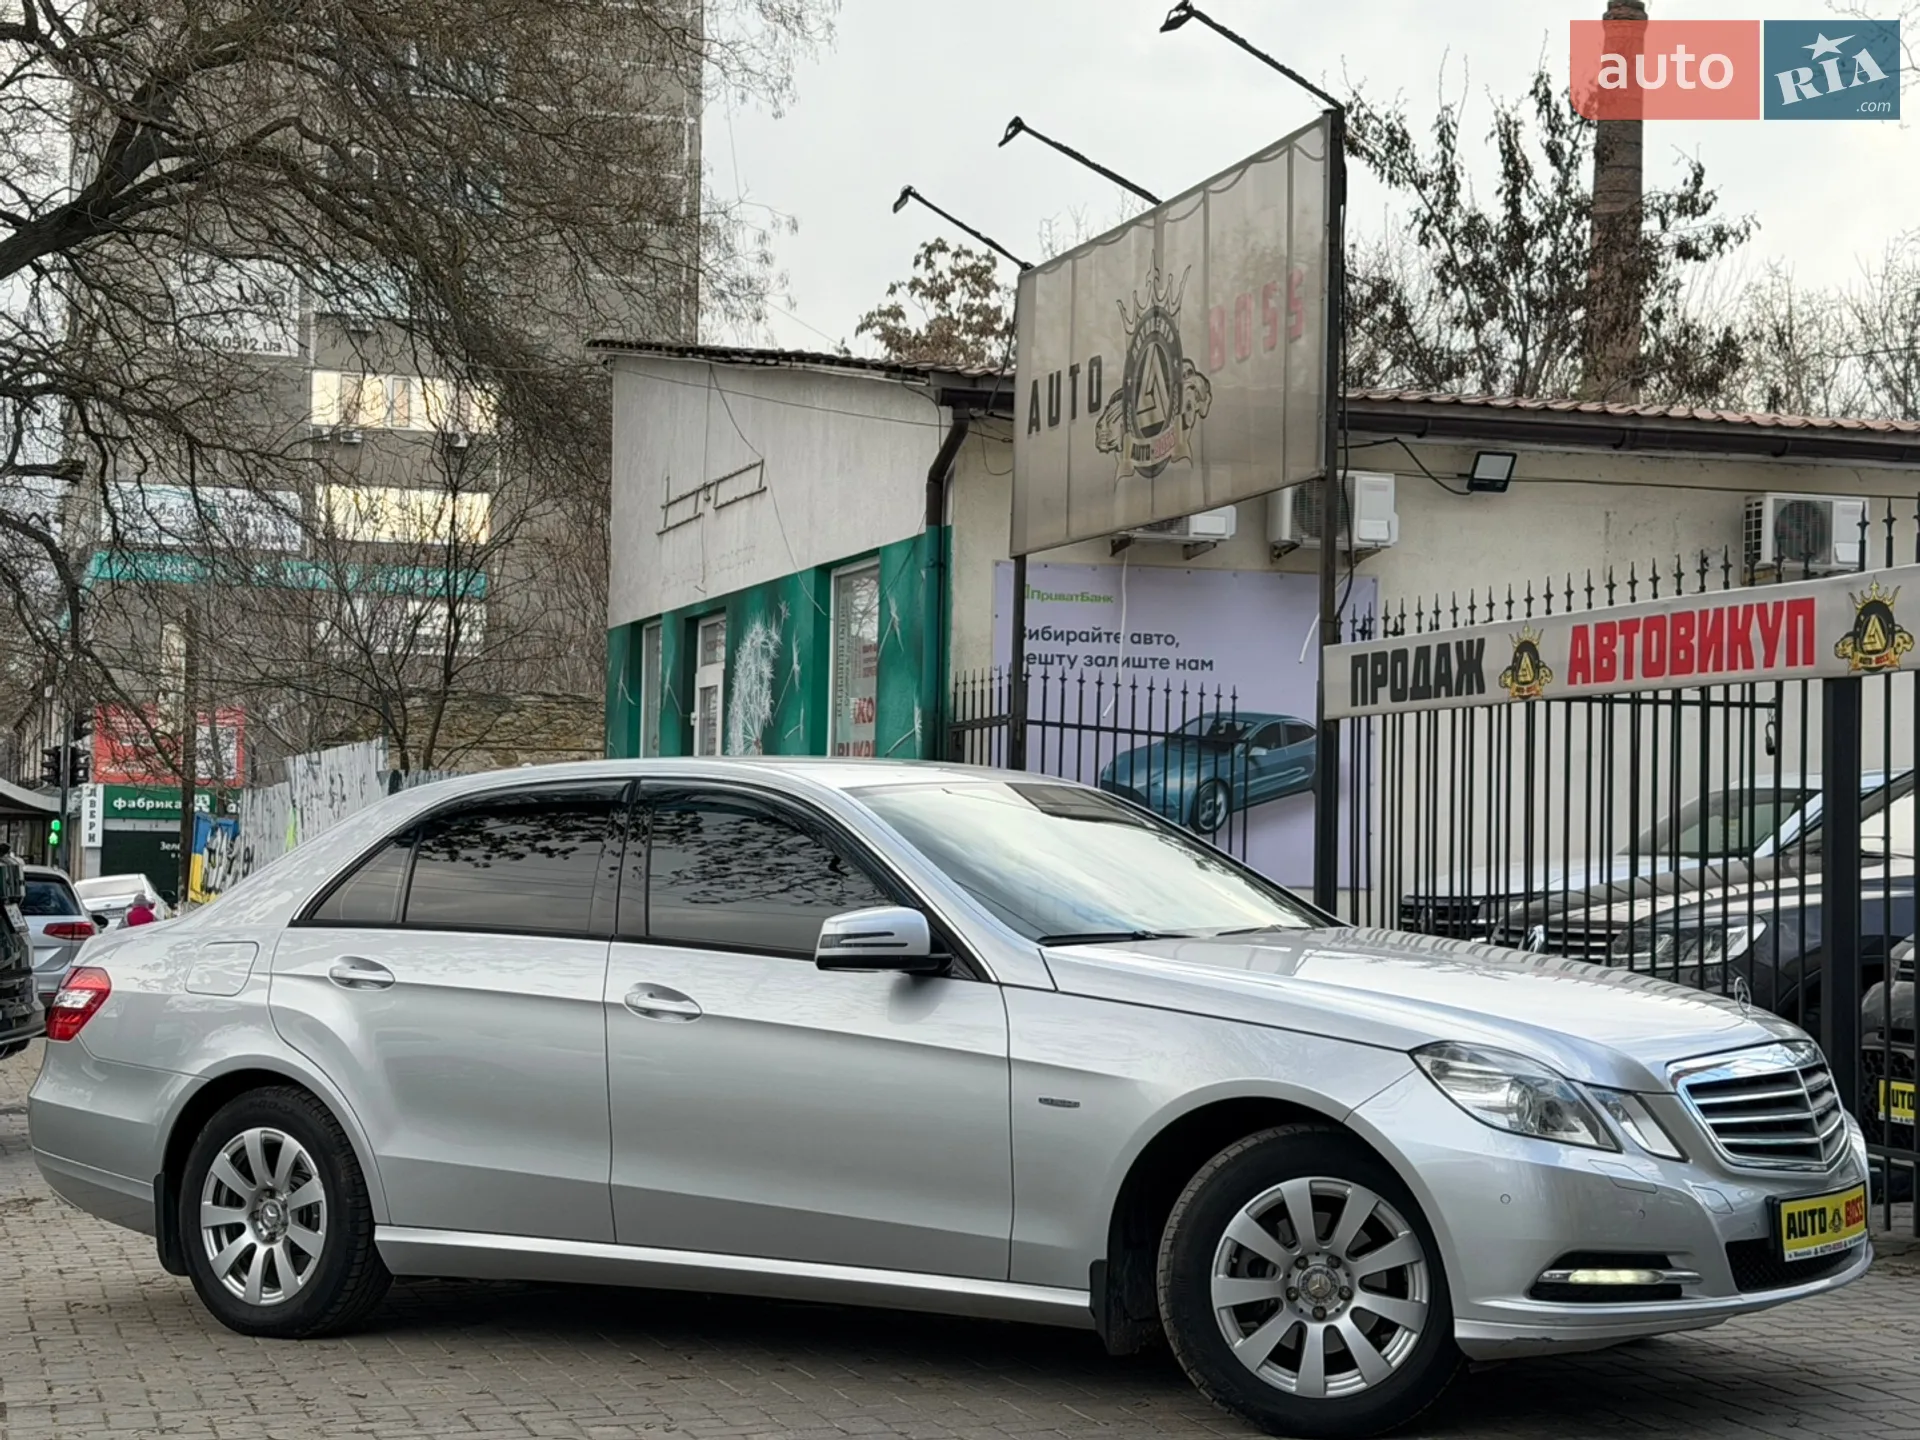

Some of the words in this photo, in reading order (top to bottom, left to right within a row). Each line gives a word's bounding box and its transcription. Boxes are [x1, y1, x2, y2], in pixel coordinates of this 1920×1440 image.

[1027, 354, 1103, 436] AUTO
[1208, 269, 1306, 374] BOSS
[1031, 588, 1114, 603] ПриватБанк
[1024, 625, 1124, 646] ибирайте
[1130, 631, 1180, 648] авто,
[1083, 654, 1171, 670] залиште
[1176, 658, 1214, 672] нам
[1350, 637, 1486, 708] ПРОДАЖ
[1567, 596, 1816, 686] АВТОВИКУП
[112, 797, 183, 811] фабрика
[1883, 1088, 1916, 1110] UTO
[1786, 1207, 1828, 1240] AUTO
[1844, 1195, 1864, 1228] BOSS
